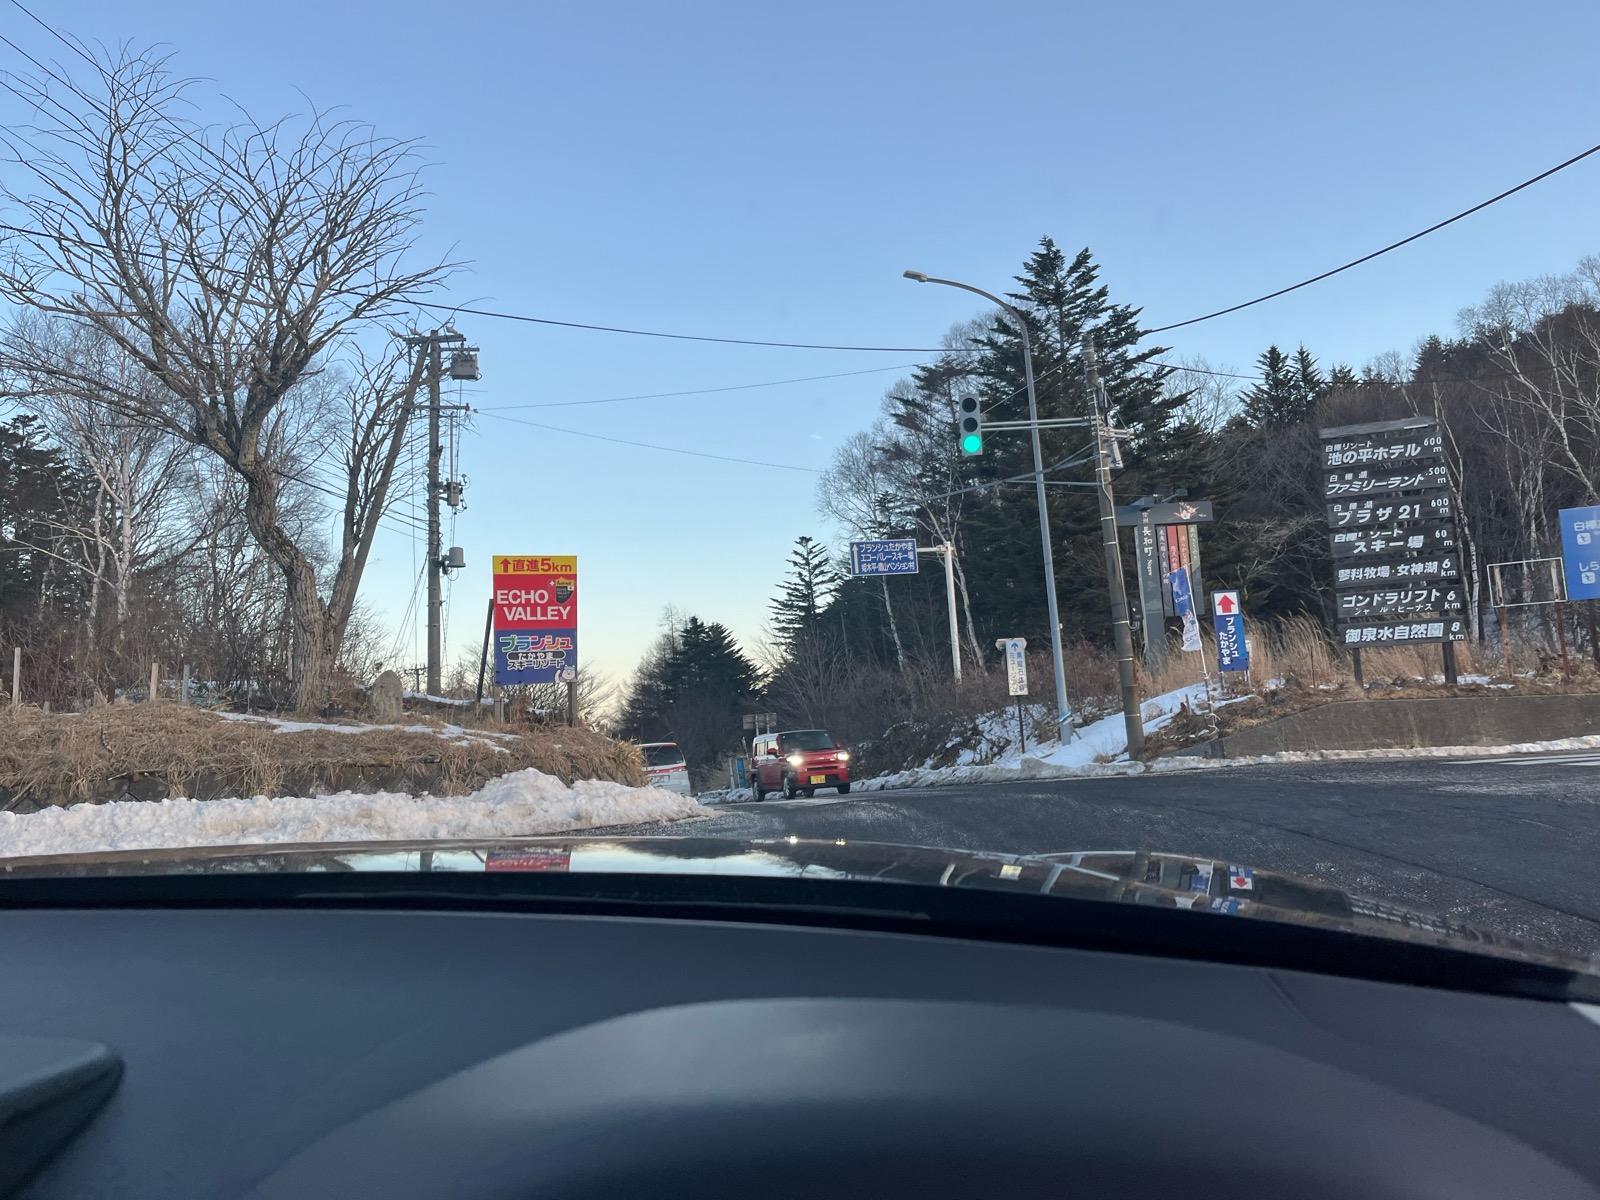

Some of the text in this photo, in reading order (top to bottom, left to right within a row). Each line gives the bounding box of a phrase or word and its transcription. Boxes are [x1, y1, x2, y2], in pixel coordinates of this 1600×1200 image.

[1423, 437, 1442, 446] 600
[1327, 443, 1421, 466] 池の平ホテル
[1428, 467, 1446, 475] 500
[1431, 498, 1449, 507] 600
[1435, 530, 1447, 538] 60
[1142, 526, 1153, 557] 長和町
[1353, 535, 1424, 554] スキー場
[860, 542, 913, 553] ブランシュたかやま
[512, 557, 572, 572] 直進5km
[1442, 558, 1451, 569] 6
[1440, 569, 1456, 577] km
[496, 589, 549, 605] ECHO
[1342, 588, 1441, 608] ゴンドラリフト
[1446, 590, 1456, 601] 6
[503, 606, 571, 621] VALLEY
[1451, 622, 1460, 632] 8
[1225, 616, 1240, 658] ブランシュ
[1449, 632, 1464, 641] km
[500, 634, 574, 652] ブランシュ
[1219, 631, 1231, 665] たかやま
[518, 652, 554, 660] たかやま
